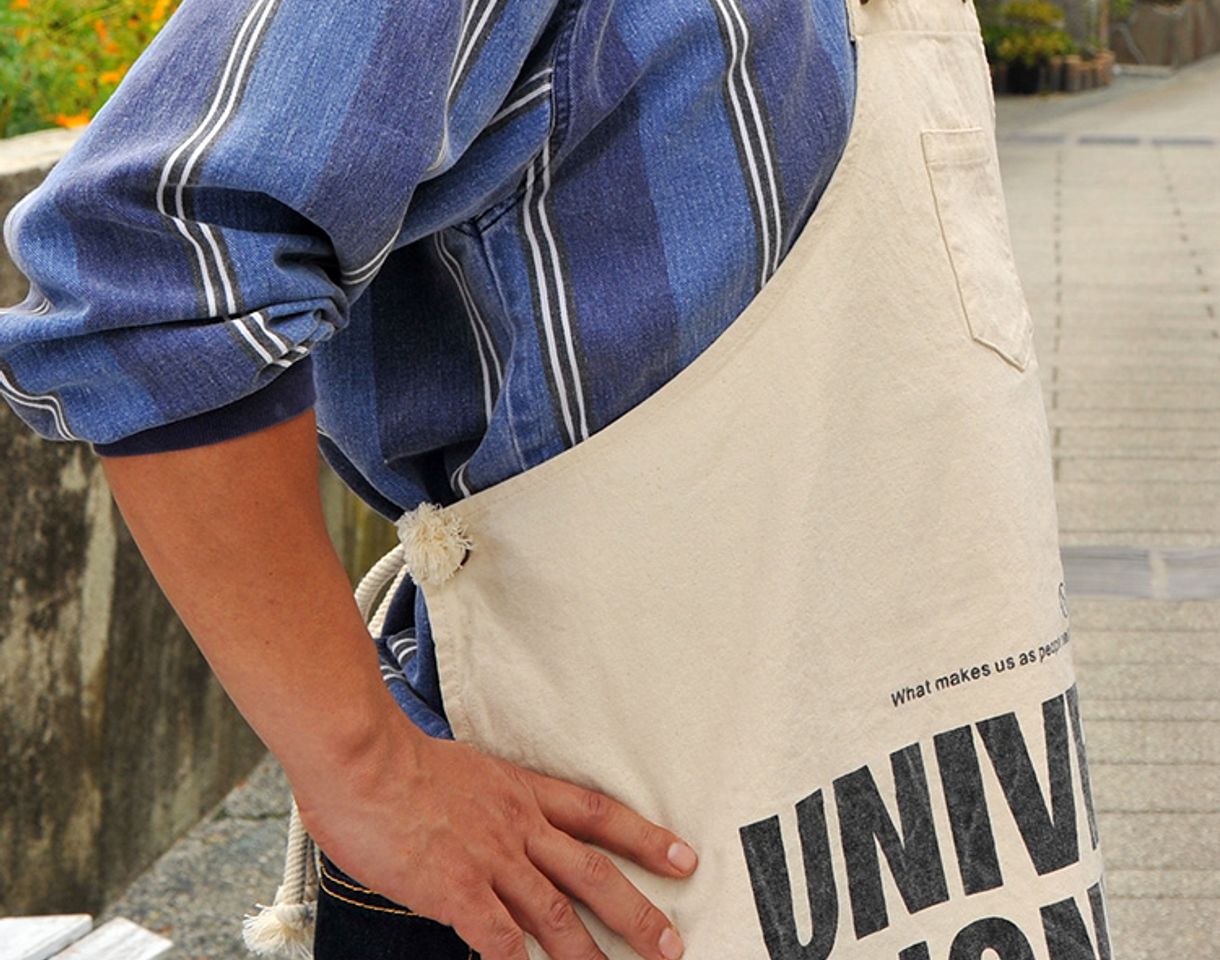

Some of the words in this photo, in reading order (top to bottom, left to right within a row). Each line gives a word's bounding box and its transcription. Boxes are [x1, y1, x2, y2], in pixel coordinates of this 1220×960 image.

[890, 679, 933, 707] What
[935, 662, 991, 691] makes
[994, 654, 1016, 673] us
[1019, 649, 1037, 666] as
